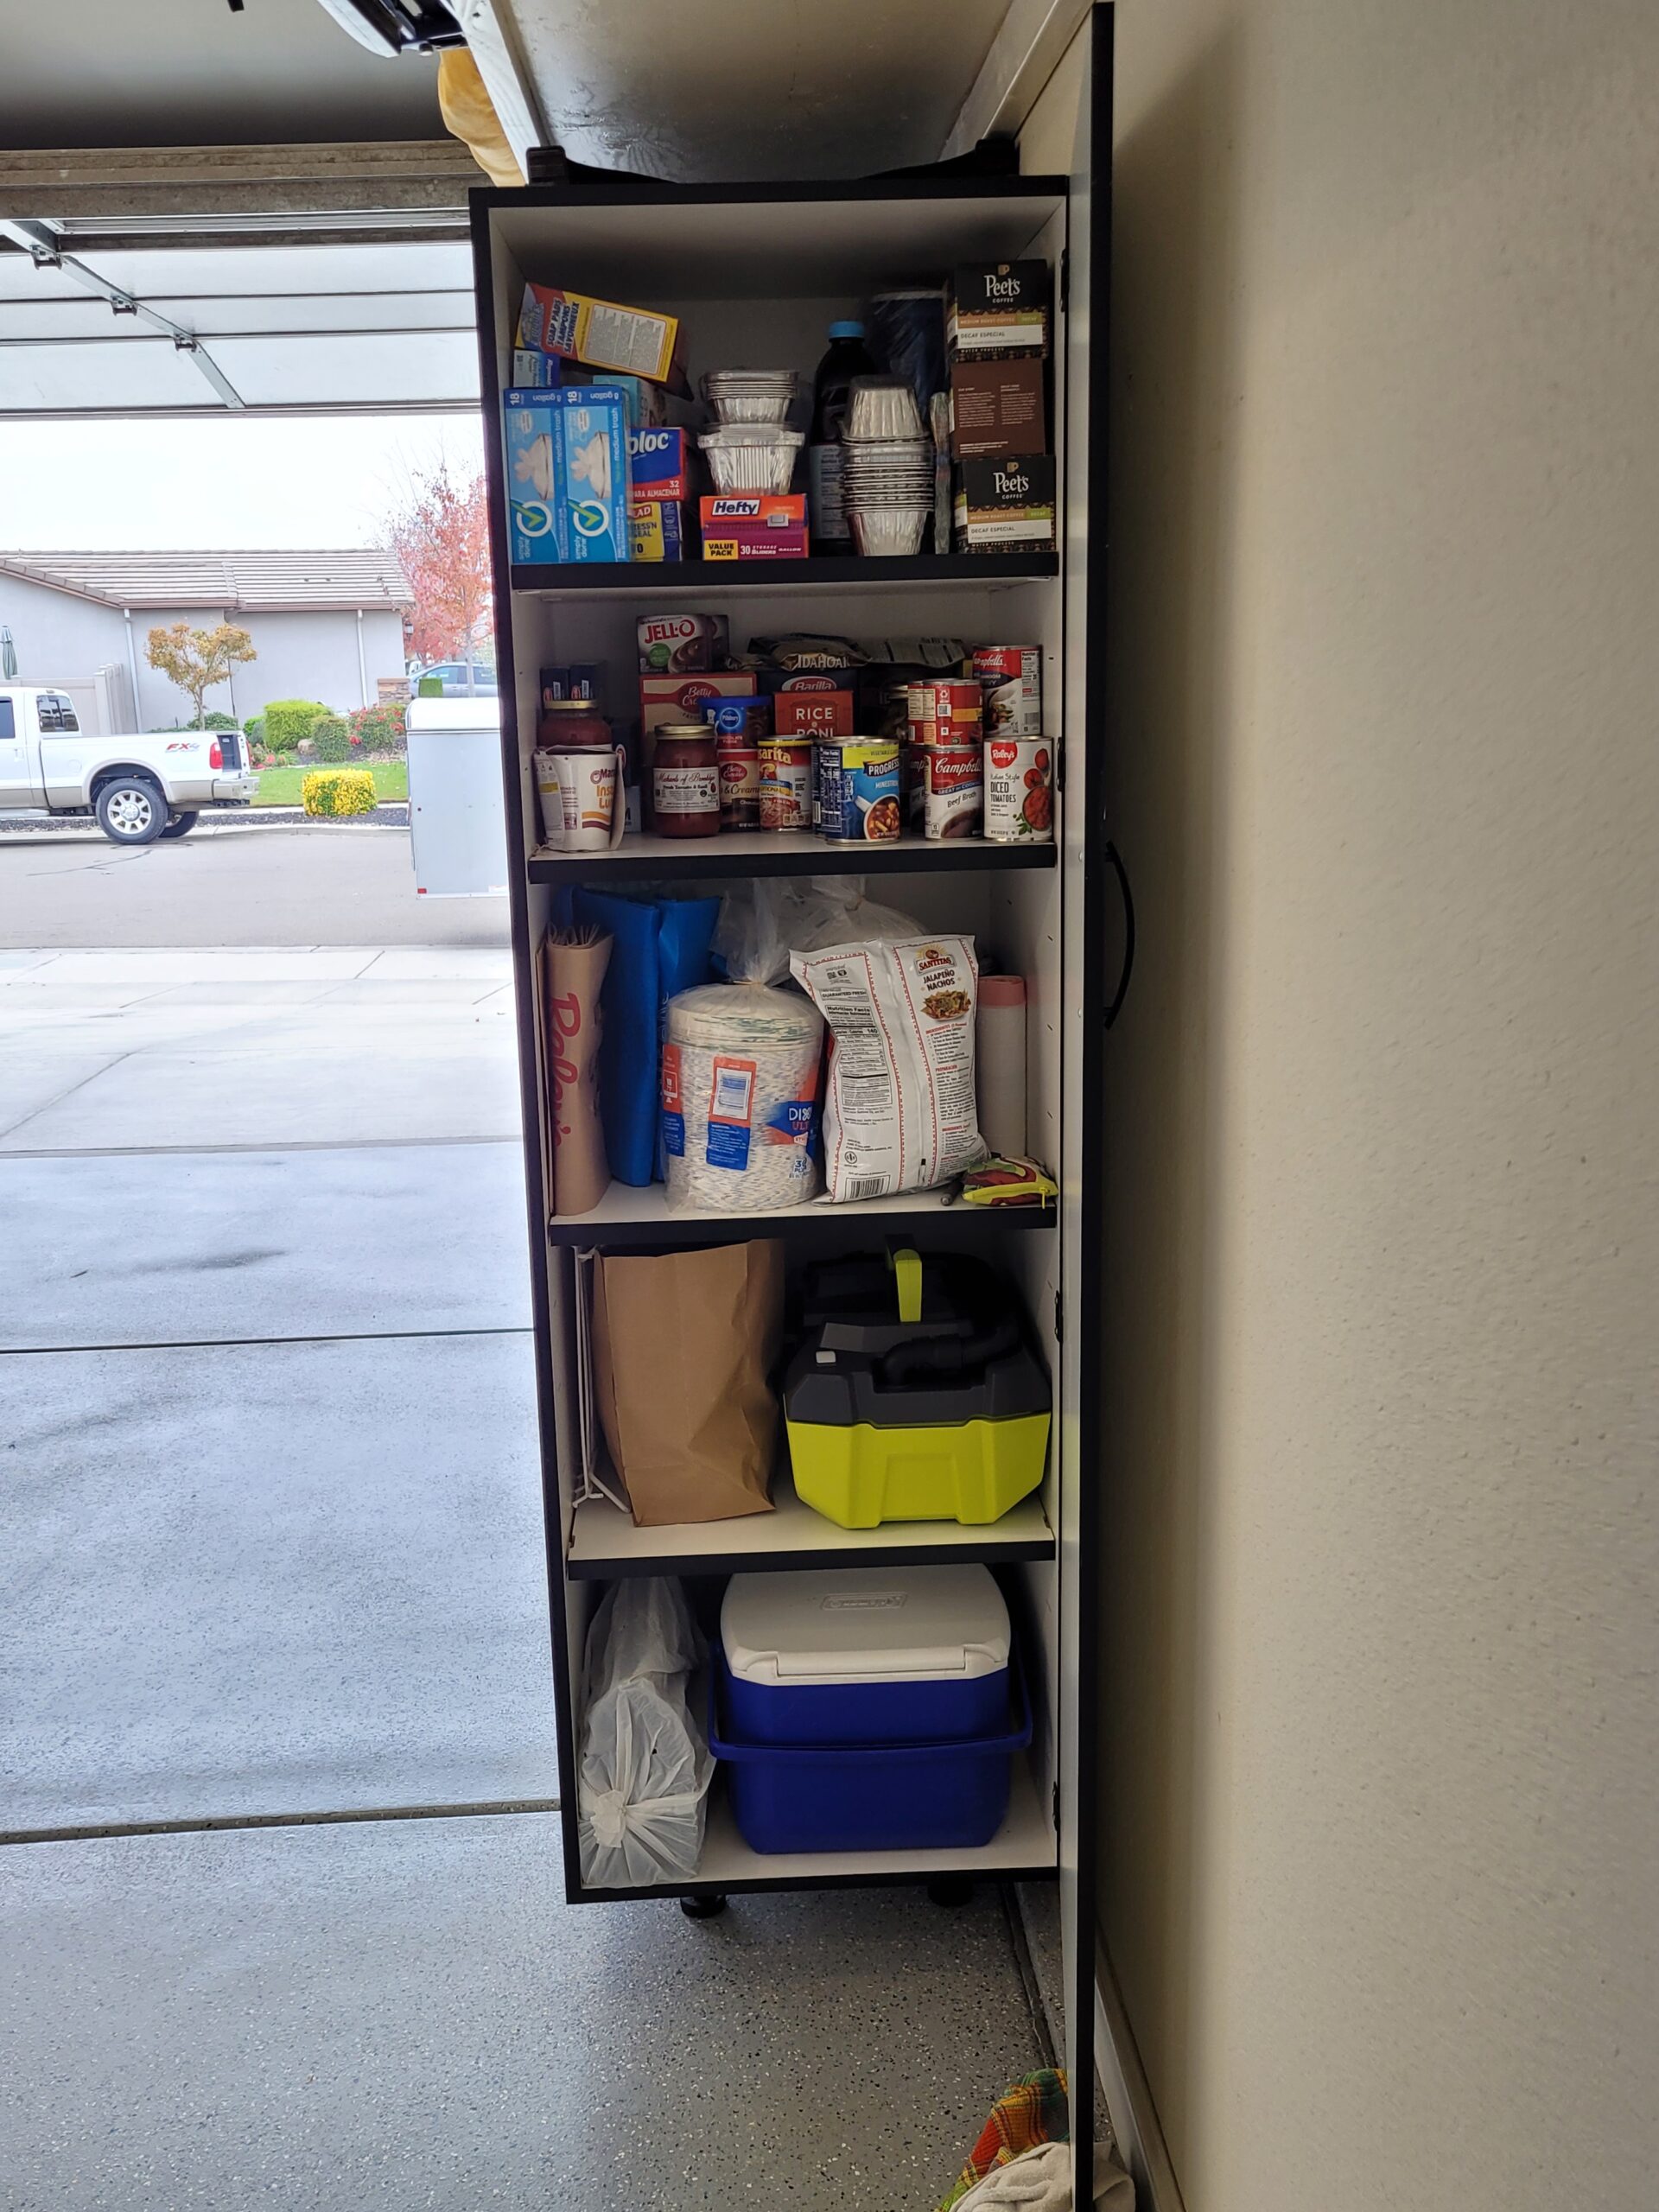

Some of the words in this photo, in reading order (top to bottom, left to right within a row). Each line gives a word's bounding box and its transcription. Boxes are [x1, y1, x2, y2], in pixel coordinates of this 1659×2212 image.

[983, 275, 1020, 297] Peet's
[548, 322, 556, 346] SOAP
[553, 299, 562, 322] PADS
[557, 305, 570, 346] TAMPONS
[510, 392, 520, 405] 18
[532, 392, 556, 403] gallon
[567, 391, 578, 404] 18
[590, 391, 613, 400] gallon
[553, 410, 563, 430] trash
[555, 432, 563, 463] medium
[628, 430, 669, 454] ploc
[993, 472, 1029, 493] Peet's
[647, 488, 680, 498] ALMACENAR
[633, 506, 652, 518] LAD
[715, 501, 757, 515] Hefty
[740, 546, 751, 555] 30
[689, 686, 712, 698] Betty
[795, 681, 832, 691] Barilla
[721, 714, 739, 722] Pillsbury
[796, 708, 833, 721] RICE
[759, 747, 792, 765] sarita
[992, 749, 1016, 760] Raley's
[869, 760, 899, 776] PROGRESS
[680, 774, 688, 785] of
[1005, 772, 1020, 783] Style
[724, 785, 730, 795] &
[731, 783, 760, 795] Cream
[938, 786, 956, 795] GREAT
[990, 781, 1009, 793] DICED
[947, 795, 961, 808] Beef
[963, 791, 976, 801] Broth
[990, 794, 1016, 803] TOMATOES
[919, 957, 952, 971] SANTITAS
[923, 969, 955, 983] JALAPEÑO
[926, 978, 956, 992] NACHOS
[789, 1106, 812, 1122] DIX
[792, 1121, 809, 1130] ULT
